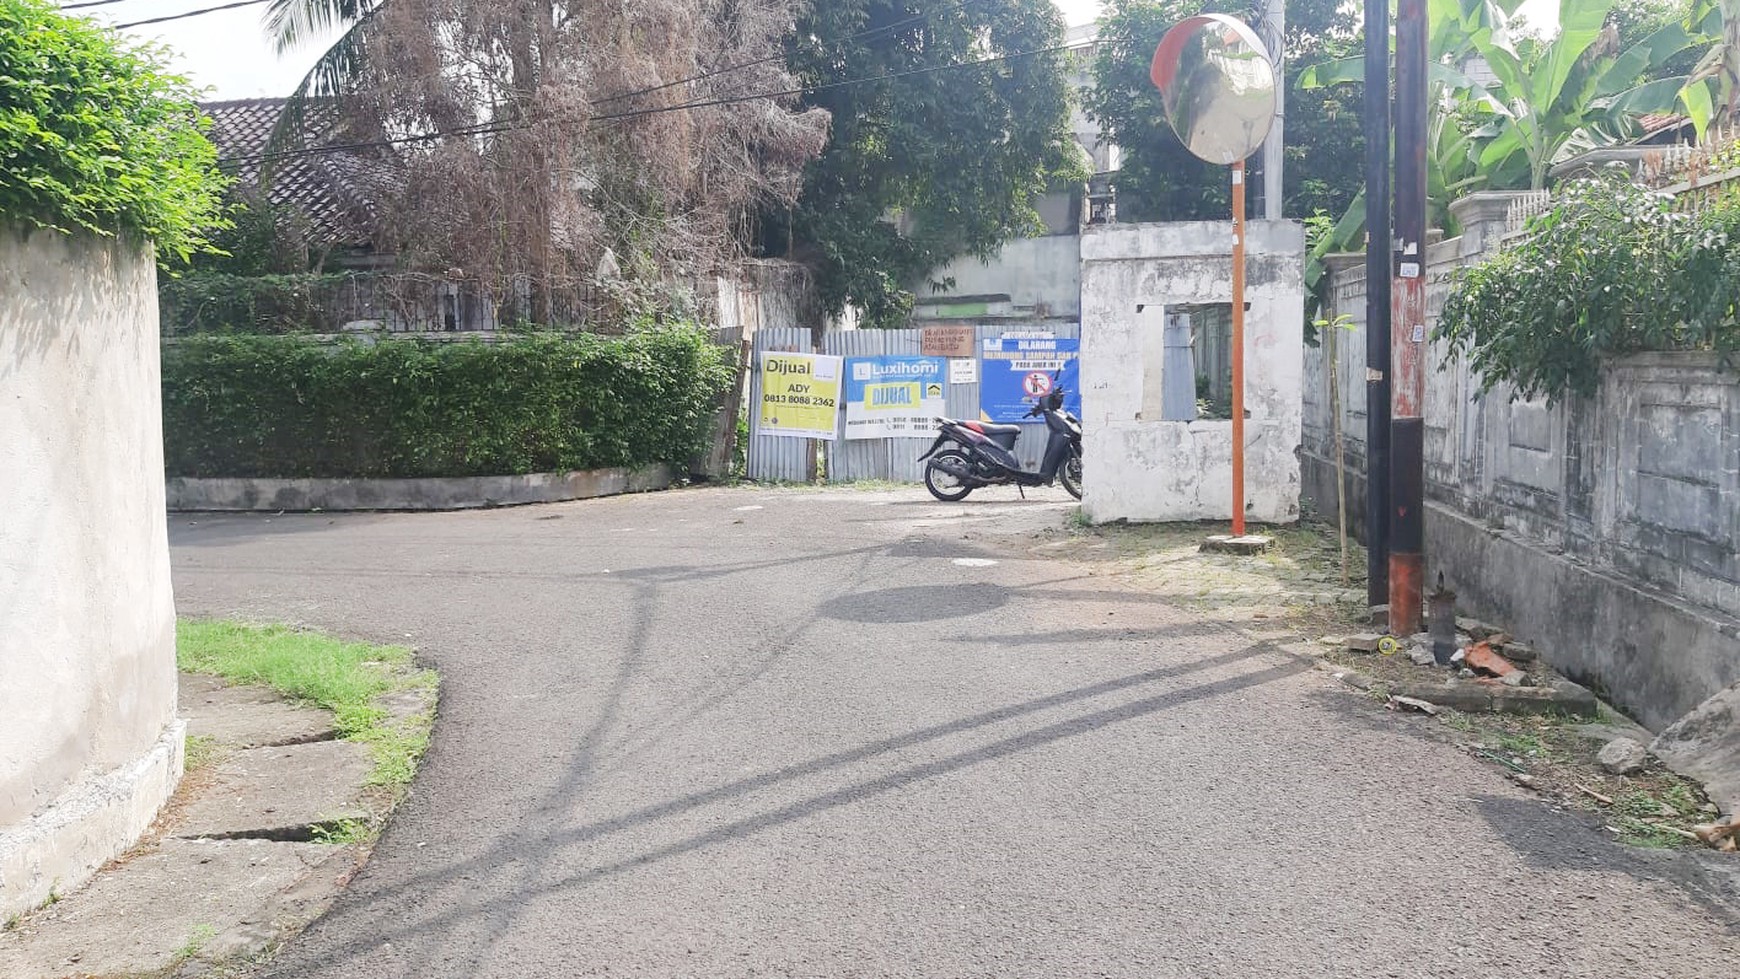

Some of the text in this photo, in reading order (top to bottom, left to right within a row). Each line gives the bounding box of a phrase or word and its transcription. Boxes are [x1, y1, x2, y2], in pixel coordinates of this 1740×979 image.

[1018, 340, 1056, 350] DILARANG
[766, 359, 811, 375] Dijual
[872, 360, 939, 375] Luxihomi
[787, 383, 810, 393] ADY
[763, 393, 786, 403] 0813
[812, 397, 835, 407] 2362
[872, 386, 912, 405] DIJUAL
